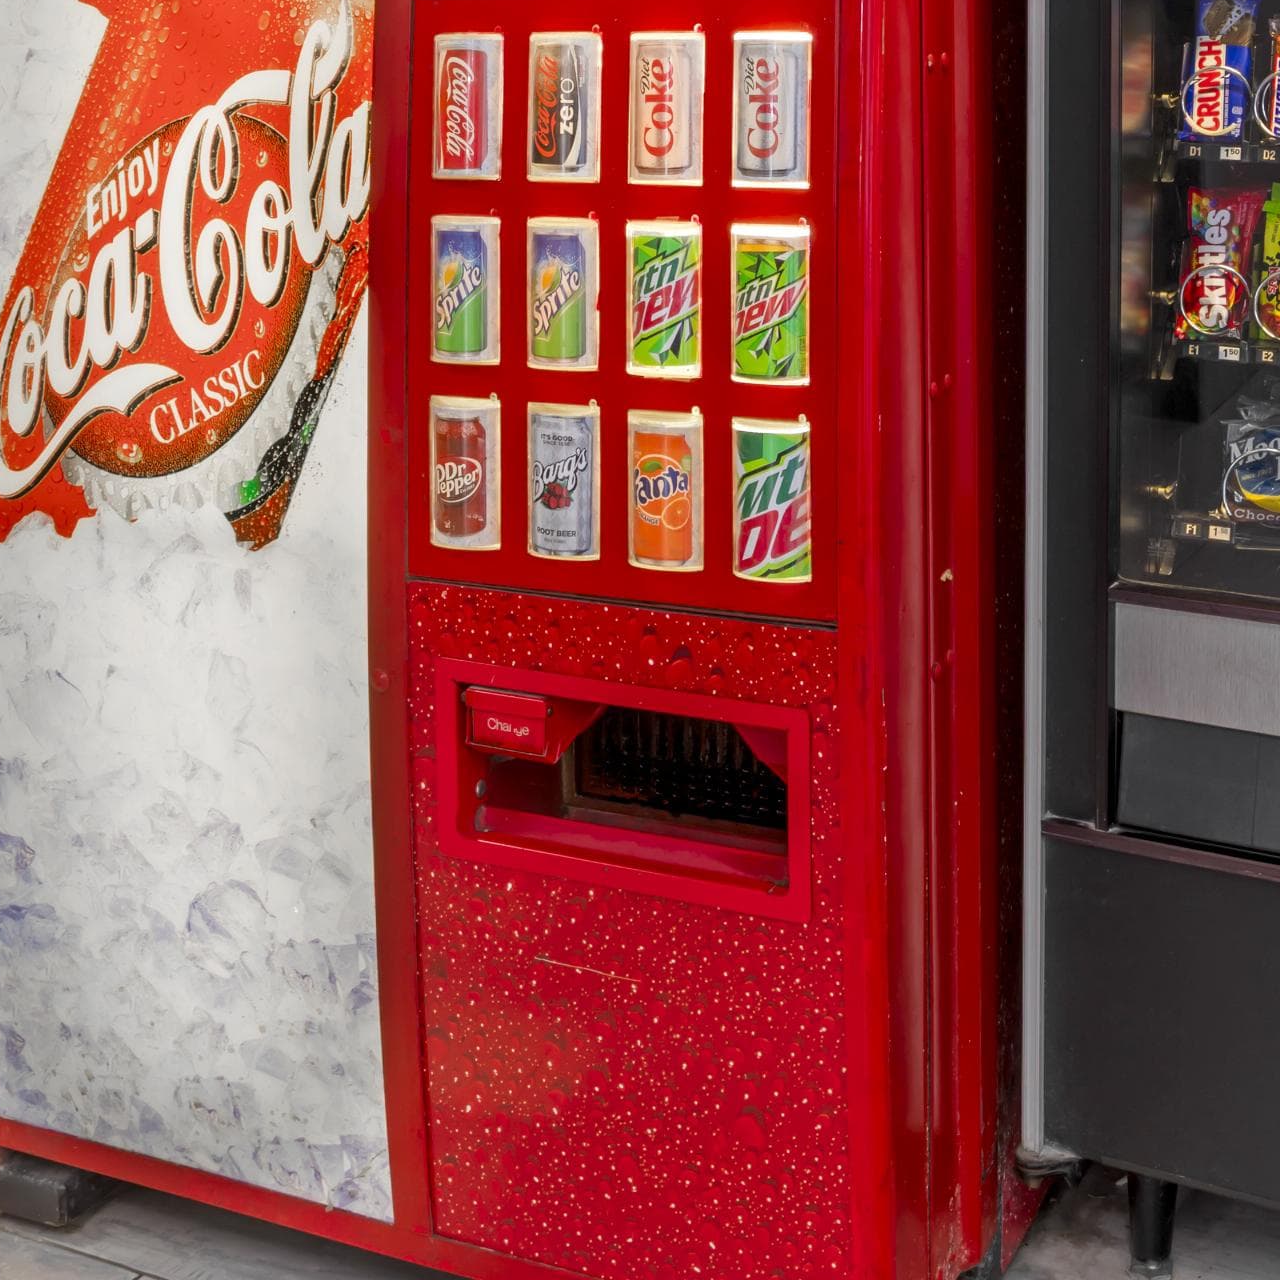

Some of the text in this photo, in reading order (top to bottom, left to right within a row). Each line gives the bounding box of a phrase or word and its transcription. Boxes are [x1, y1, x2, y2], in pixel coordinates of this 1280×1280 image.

[559, 77, 575, 136] zero
[641, 56, 651, 96] Diet
[643, 57, 674, 157] Coke
[744, 56, 755, 96] Diet
[1196, 39, 1222, 132] CRUNCH
[747, 57, 780, 159] Coke
[1190, 146, 1201, 156] D1
[85, 137, 161, 240] Enjoy
[436, 262, 483, 330] Sprite
[533, 267, 581, 337] Sprite
[1188, 345, 1200, 356] E1
[148, 350, 267, 447] CLASSIC
[534, 447, 589, 501] Barq's
[537, 526, 577, 537] ROOT BEER
